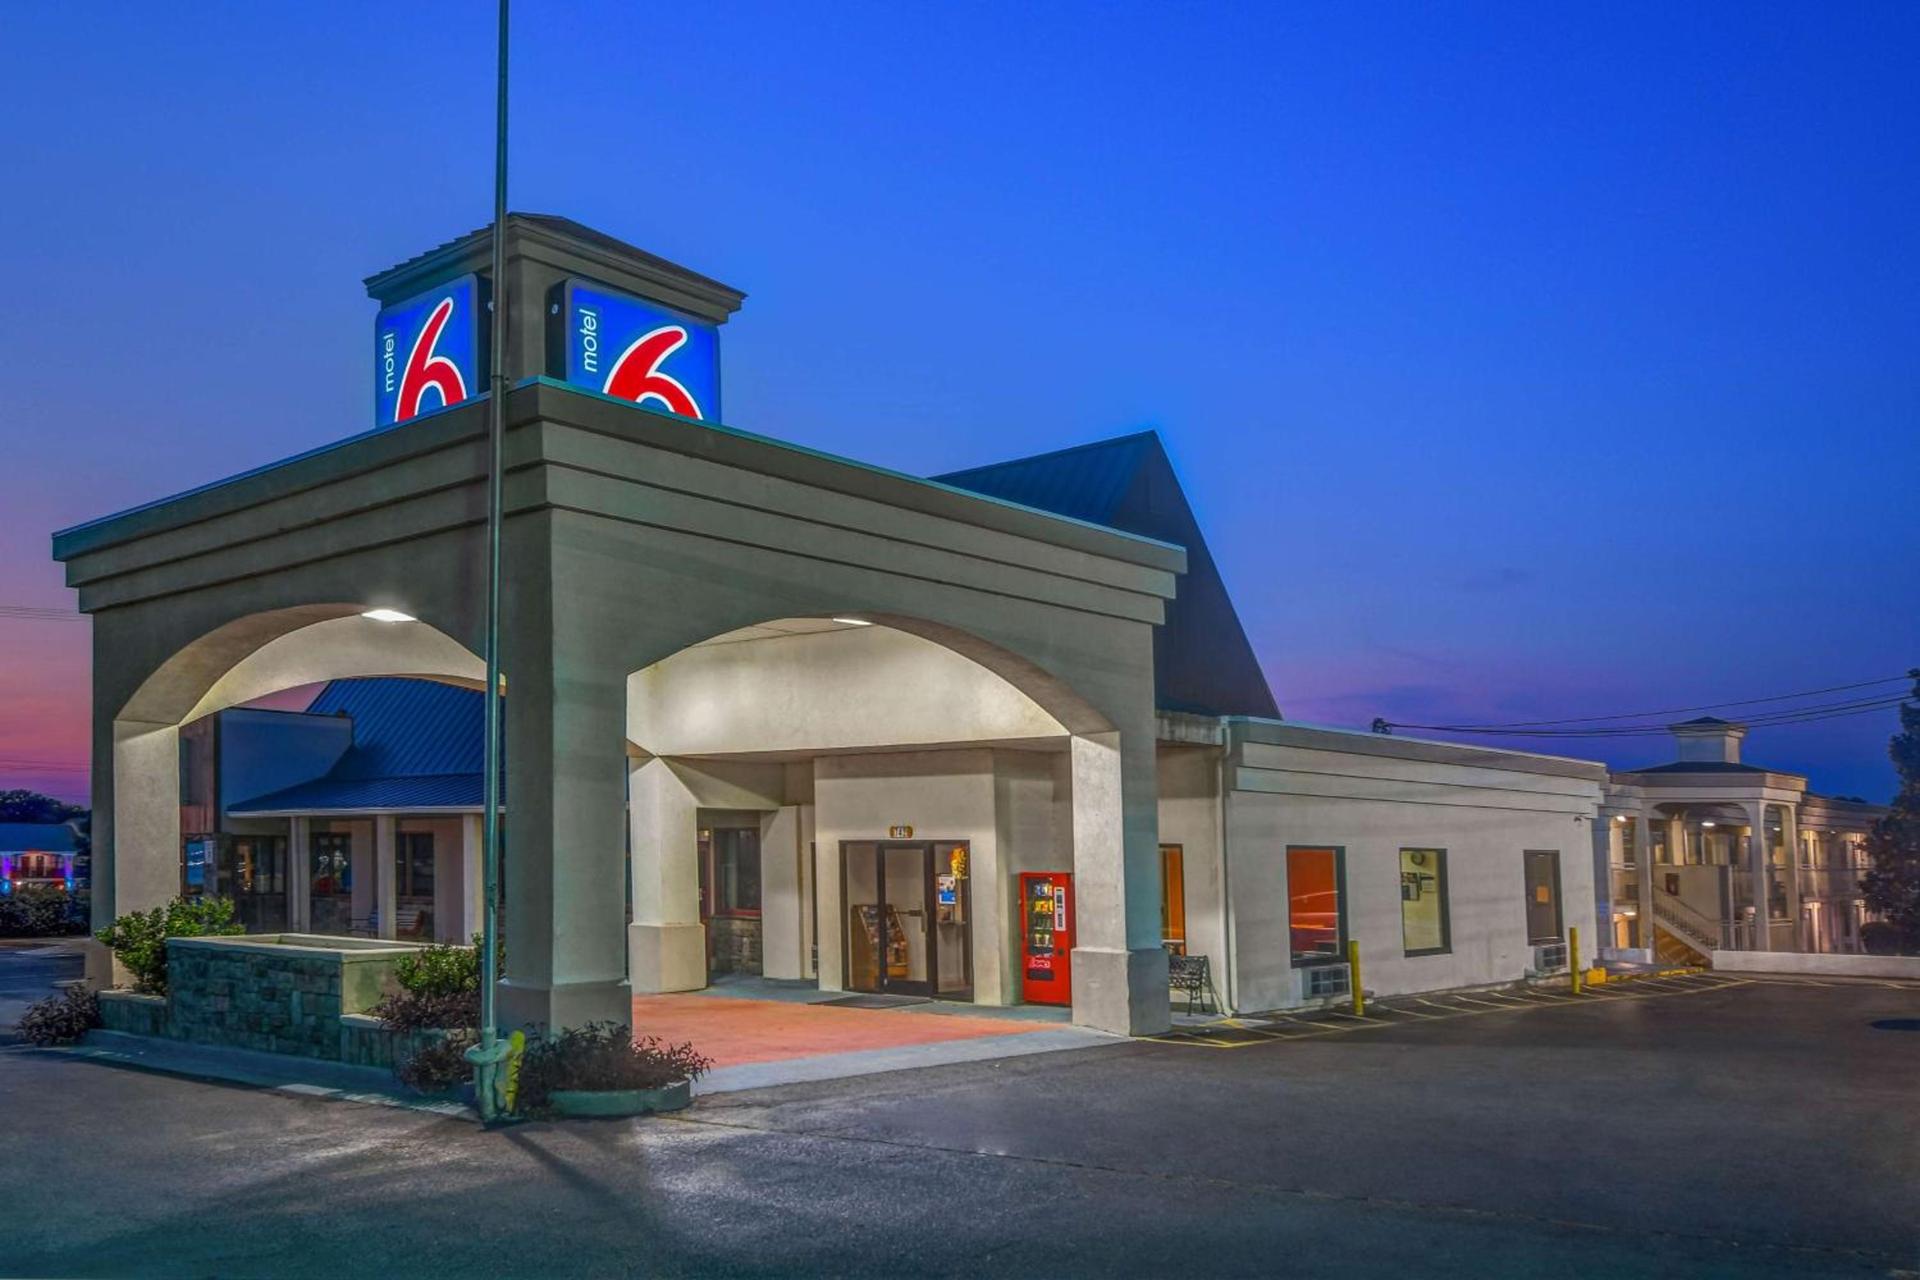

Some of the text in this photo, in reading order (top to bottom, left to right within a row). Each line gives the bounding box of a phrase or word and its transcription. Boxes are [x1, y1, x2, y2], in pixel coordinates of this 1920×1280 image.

[383, 333, 394, 392] motel
[394, 296, 467, 422] 6
[579, 309, 597, 372] motel
